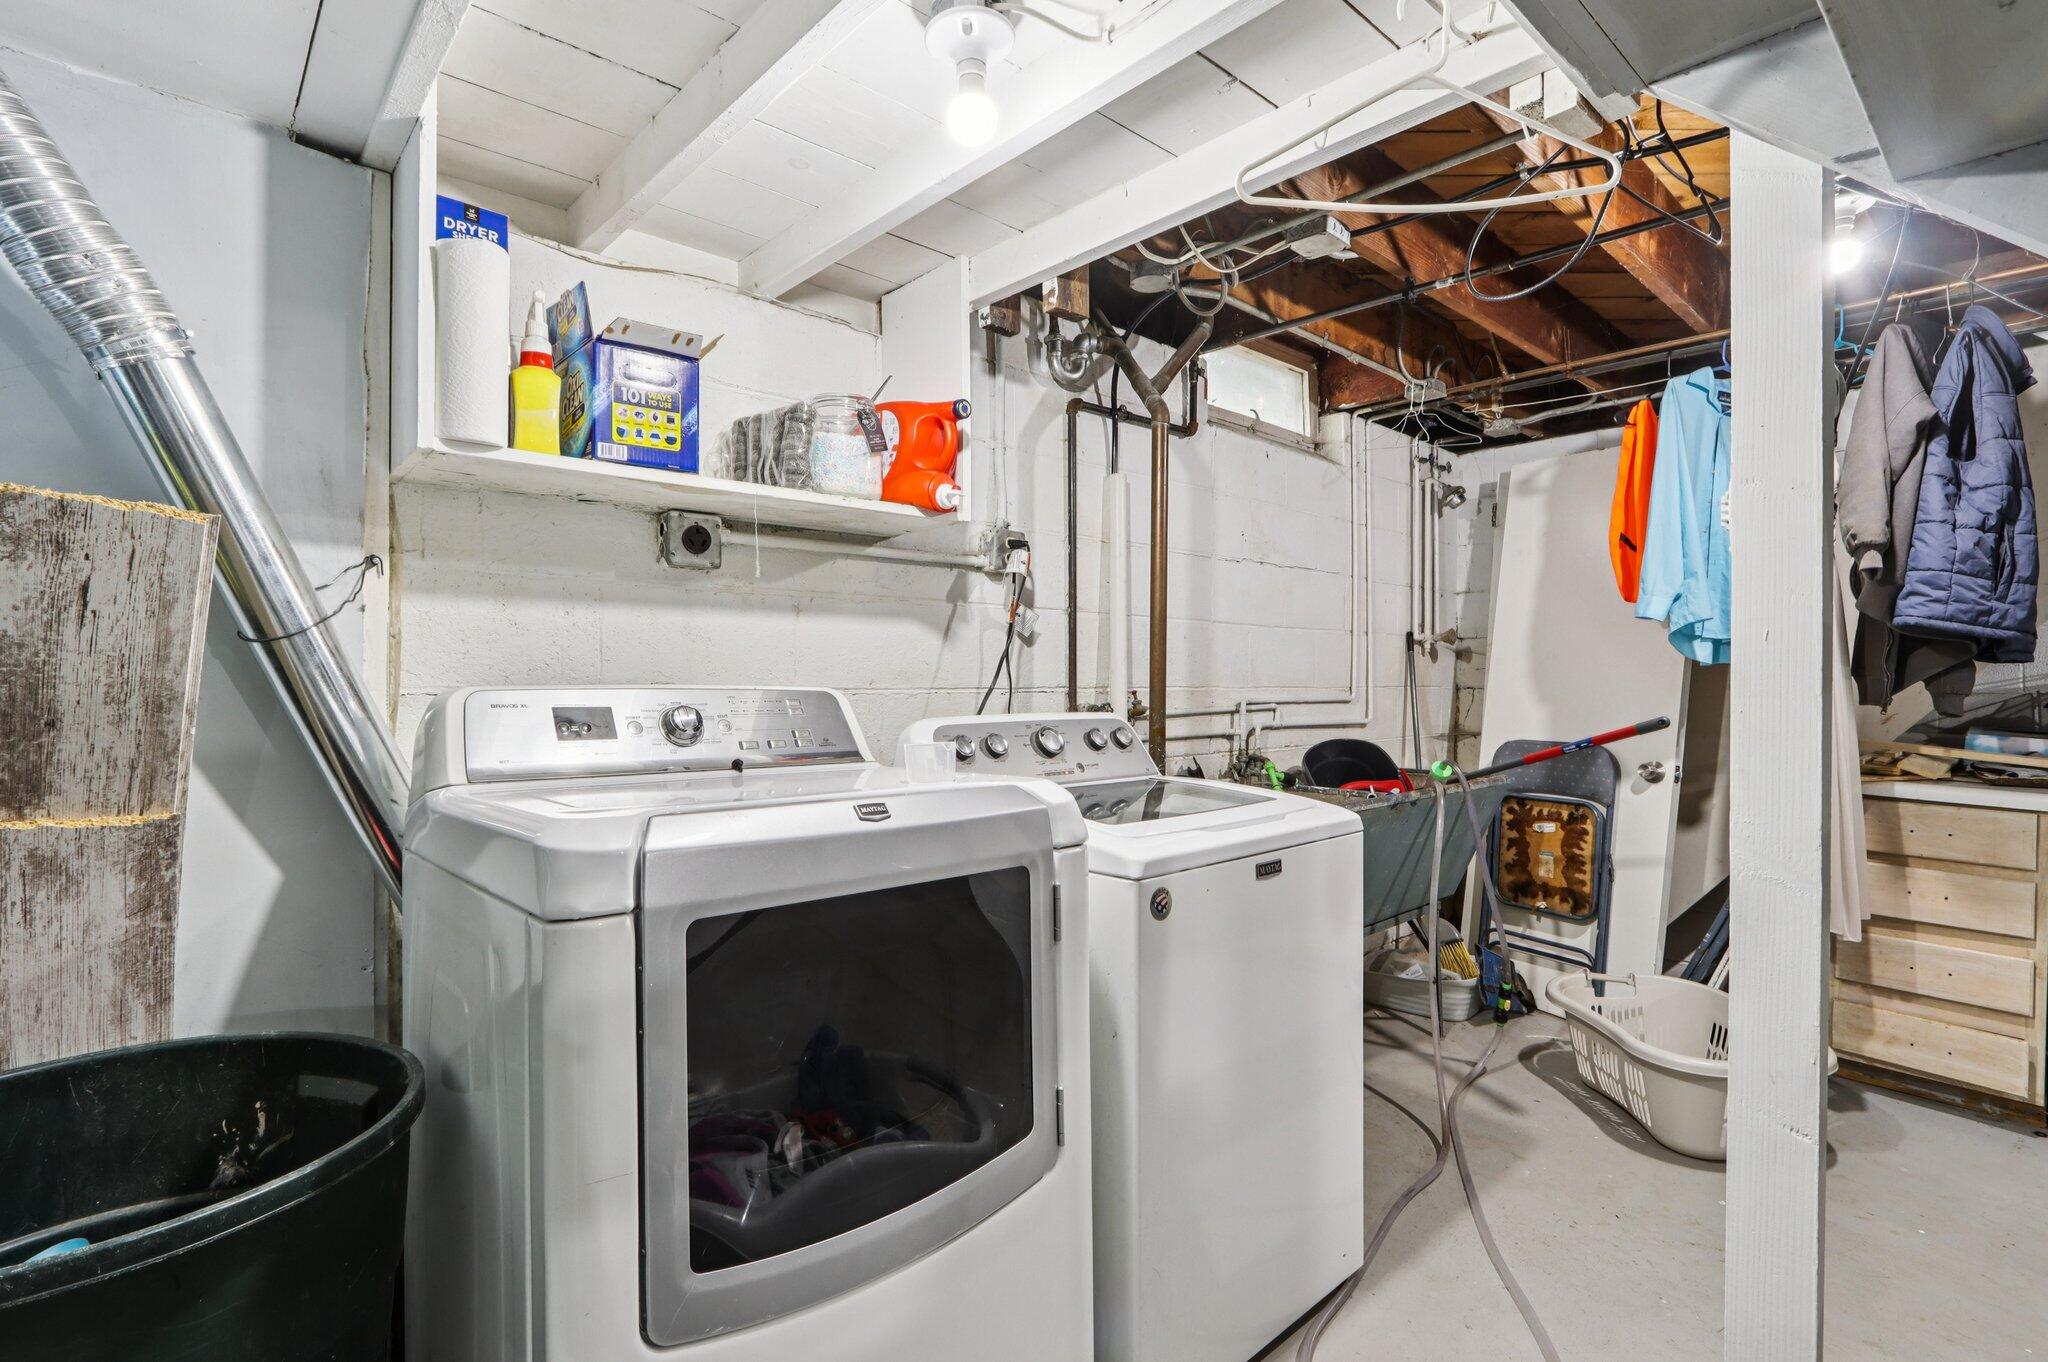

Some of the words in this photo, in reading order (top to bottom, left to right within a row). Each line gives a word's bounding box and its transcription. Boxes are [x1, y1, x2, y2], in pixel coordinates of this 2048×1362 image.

[443, 216, 499, 243] DRYER
[621, 386, 646, 405] 101
[647, 391, 672, 402] WAYS
[659, 401, 672, 409] USE
[1259, 862, 1282, 874] MAYTAG
